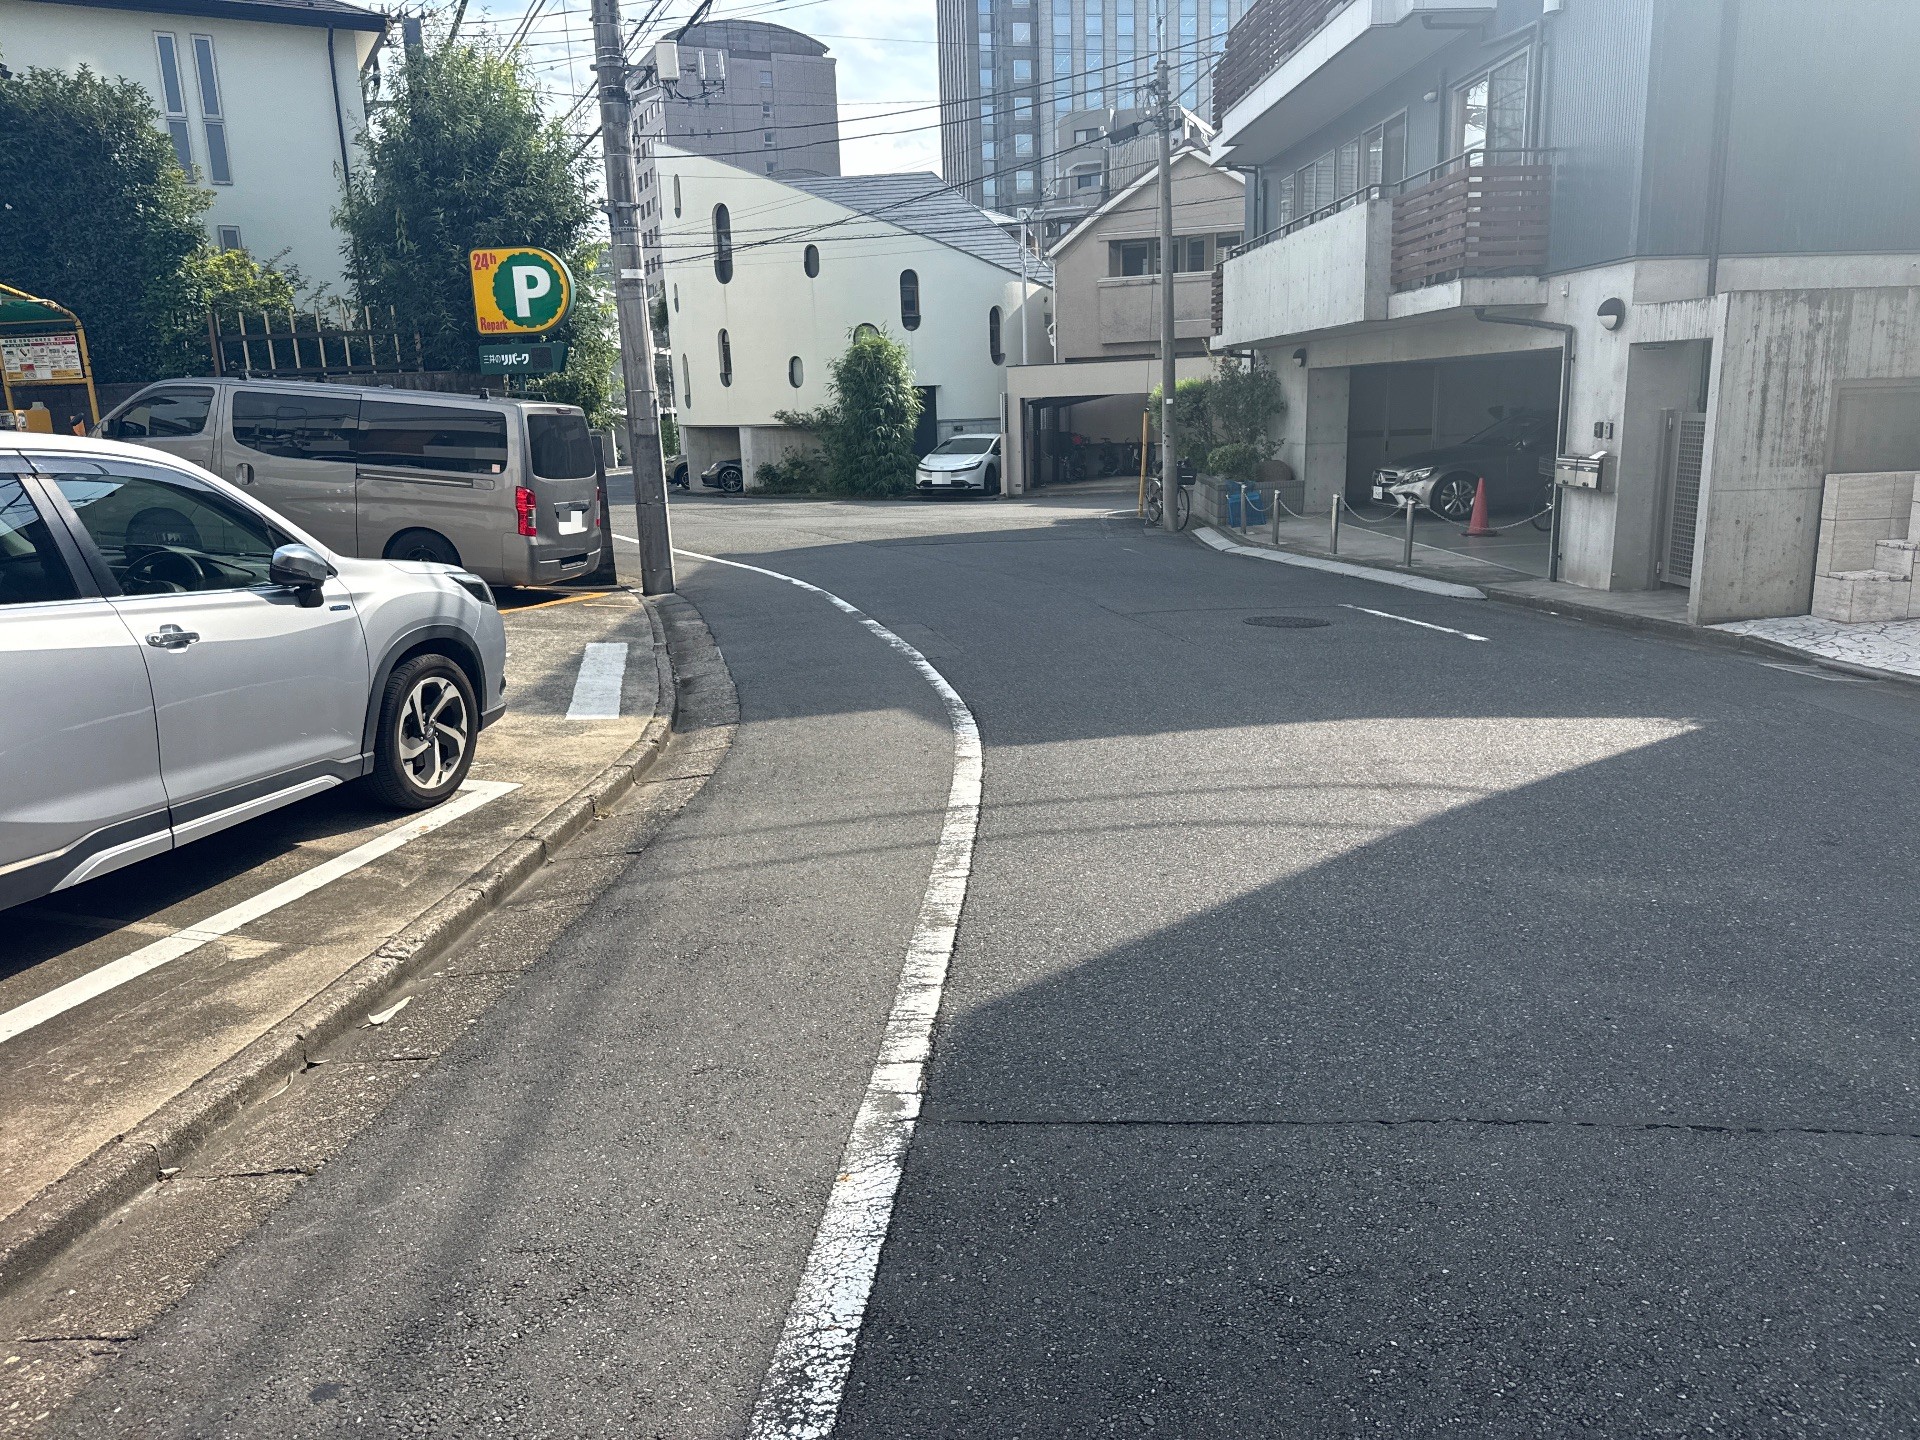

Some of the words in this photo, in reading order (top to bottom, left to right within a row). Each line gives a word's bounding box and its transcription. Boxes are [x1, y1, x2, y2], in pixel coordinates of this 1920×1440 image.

[473, 253, 496, 271] 24h
[512, 265, 551, 317] P
[480, 317, 508, 332] Repark
[483, 353, 530, 366] 三井のリパーク
